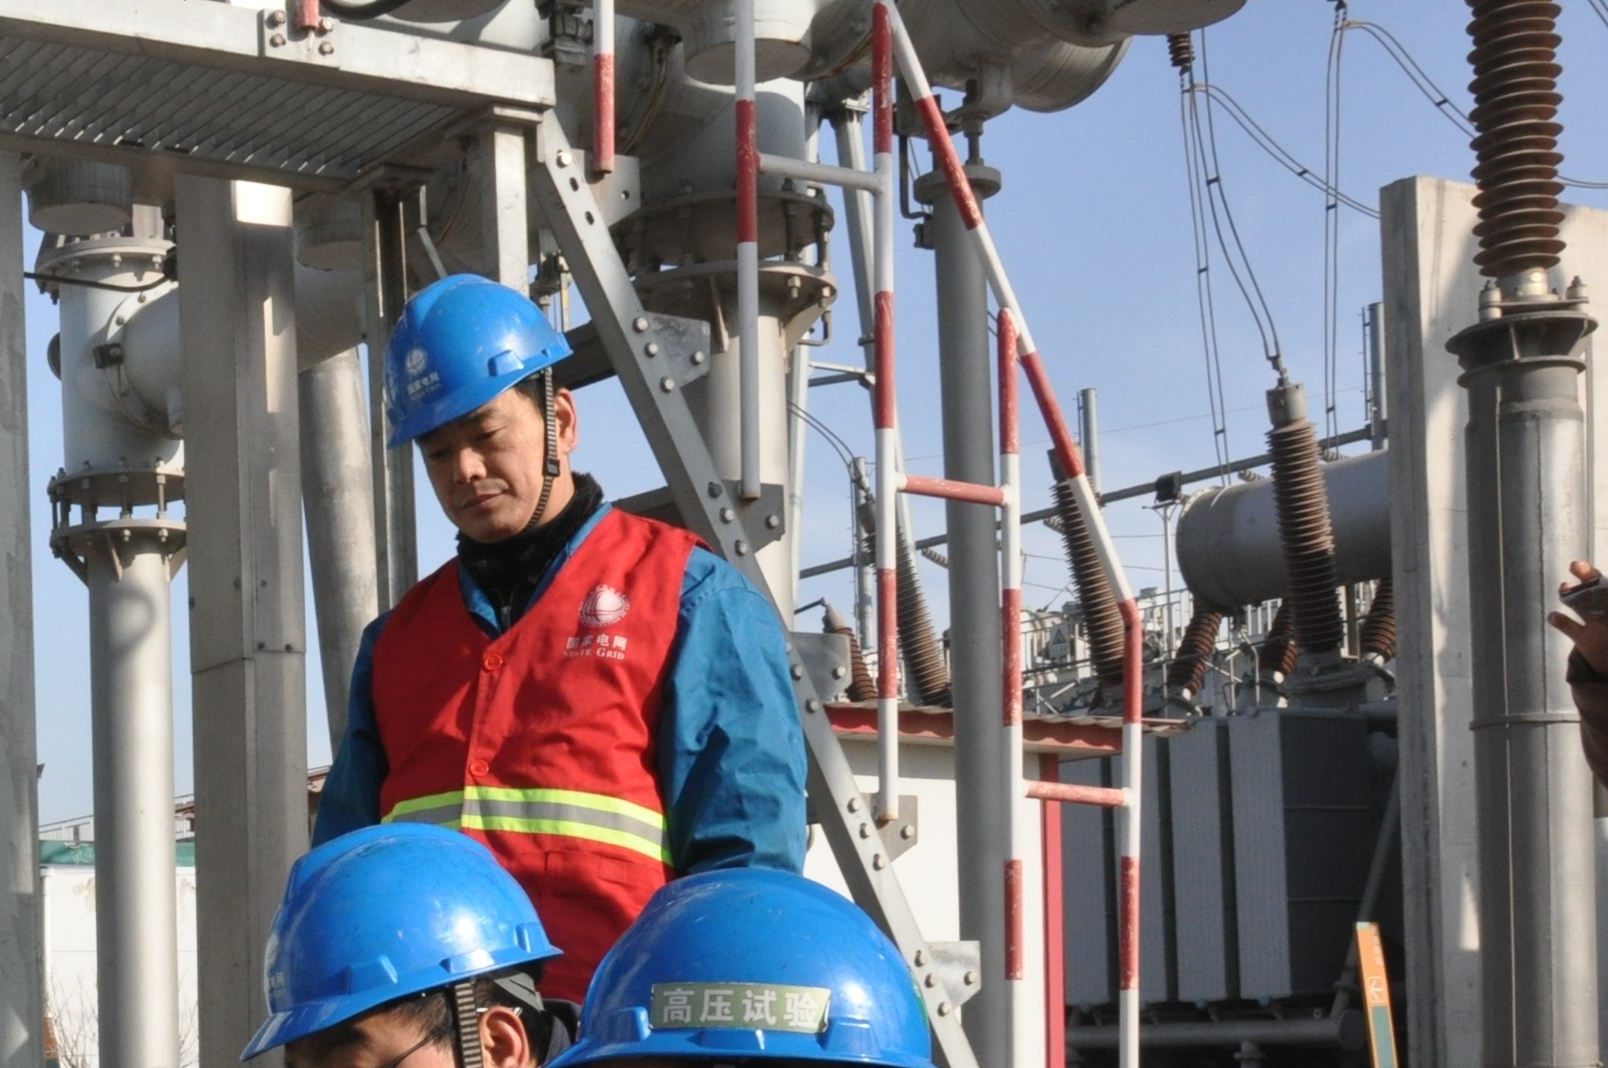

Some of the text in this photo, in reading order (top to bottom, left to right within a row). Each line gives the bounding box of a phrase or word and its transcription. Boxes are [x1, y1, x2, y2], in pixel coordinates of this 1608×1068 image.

[565, 633, 628, 651] 国家电网
[661, 988, 821, 1028] 高压试验
